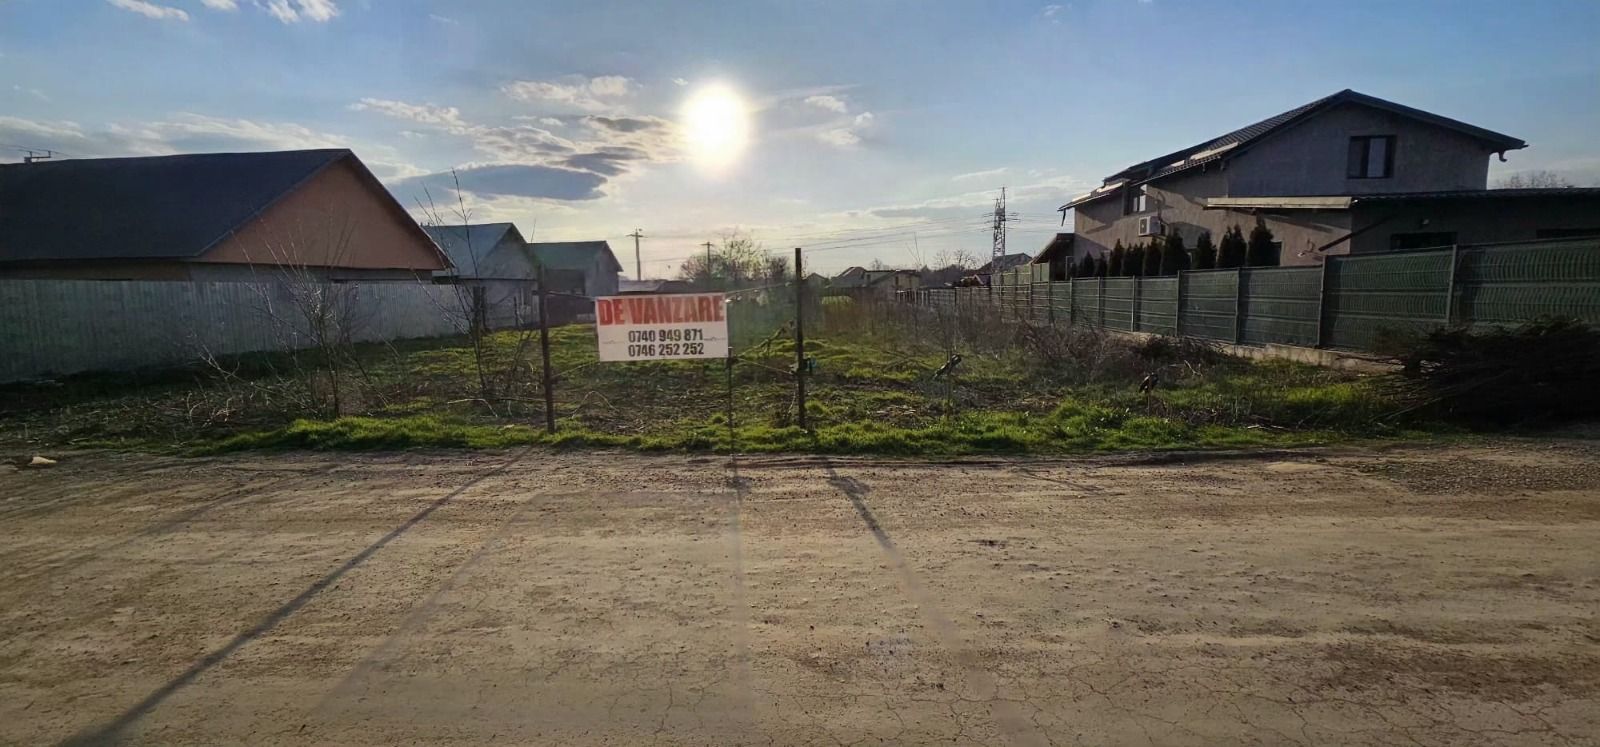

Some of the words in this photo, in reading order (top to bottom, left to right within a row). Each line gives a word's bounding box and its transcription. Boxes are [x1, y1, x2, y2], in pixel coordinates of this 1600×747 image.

[598, 299, 625, 325] DE
[628, 295, 724, 325] VANZARE
[628, 330, 656, 343] 0740
[658, 329, 681, 342] 949
[684, 328, 703, 341] 871
[628, 344, 656, 357] 0746
[658, 343, 680, 356] 252
[682, 342, 704, 355] 252
